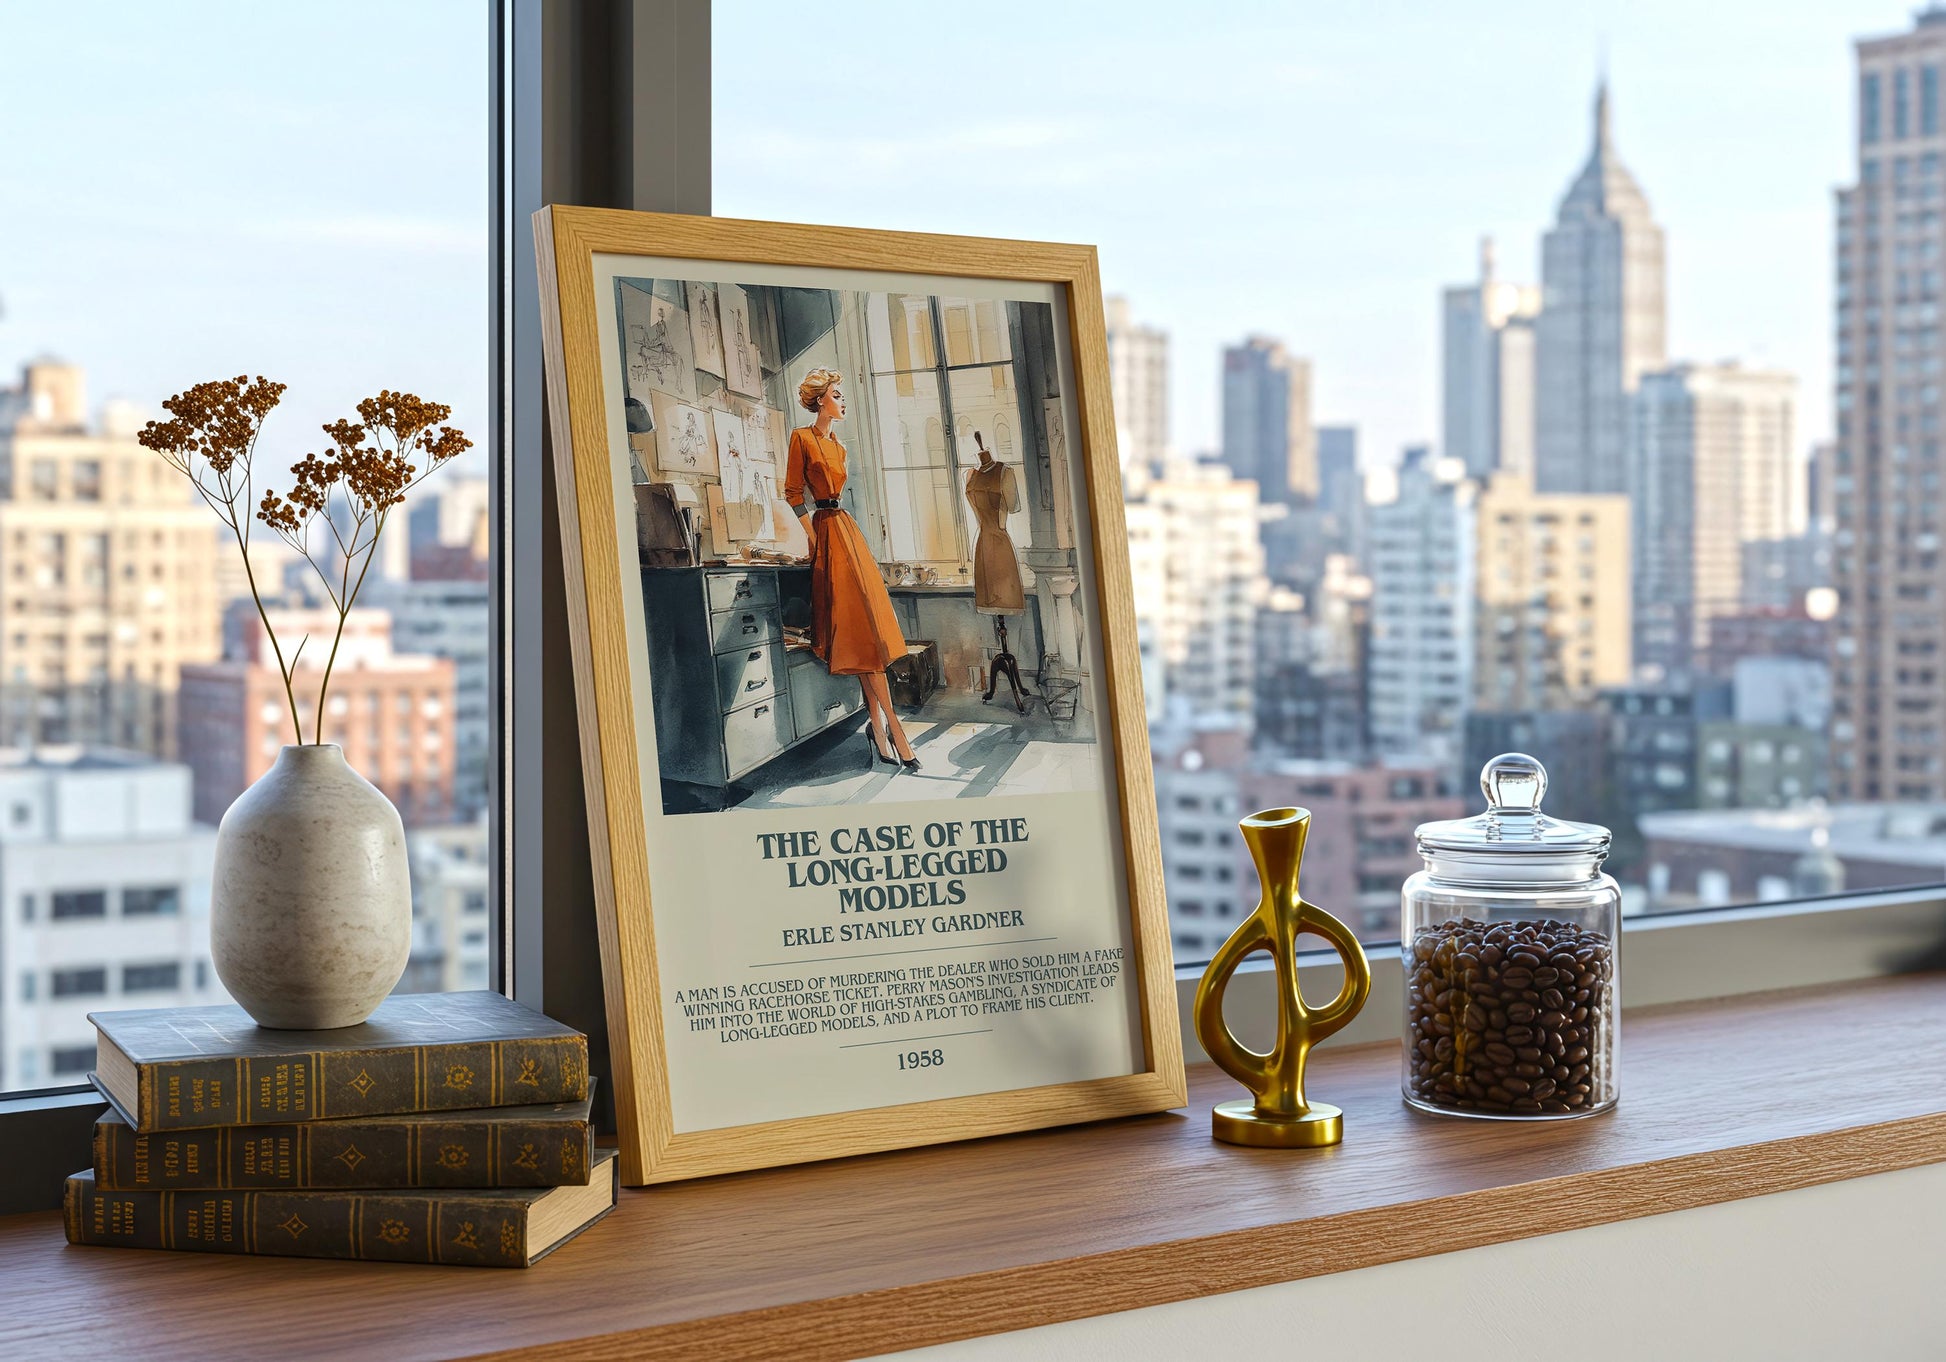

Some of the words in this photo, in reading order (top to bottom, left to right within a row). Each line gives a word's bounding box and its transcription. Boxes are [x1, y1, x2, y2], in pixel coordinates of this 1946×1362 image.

[756, 830, 821, 860] THE
[830, 825, 915, 855] CASE
[923, 821, 964, 848] OF
[970, 817, 1029, 845] THE
[786, 848, 1007, 888] LONG-LEGGED
[838, 879, 966, 914] MODELS
[782, 926, 835, 947] ERLE
[840, 918, 926, 942] STANLEY
[932, 910, 1025, 933] GARDNER
[675, 991, 685, 1003] A
[688, 987, 719, 1002] MAN
[723, 985, 736, 999] IS
[740, 979, 804, 997] ACCUSED
[808, 977, 826, 990] OF
[830, 969, 906, 988] MURDERING
[909, 966, 935, 980] THE
[938, 961, 986, 977] DEALER
[989, 958, 1019, 972] WHO
[1022, 955, 1055, 969] SOLD
[1058, 952, 1080, 965] HIM
[1083, 951, 1092, 963] A
[1095, 948, 1125, 962] FAKE
[683, 999, 745, 1017] WINNING
[748, 991, 831, 1011] RACEHORSE
[832, 985, 883, 1002] TICKET.
[886, 981, 926, 996] PERRY
[929, 975, 984, 992] MASON'S
[987, 965, 1079, 986] INVESTIGATION
[1082, 962, 1120, 976] LEADS
[690, 1017, 716, 1031] HIM
[720, 1013, 753, 1028] INTO
[756, 1010, 784, 1024] THE
[787, 1005, 836, 1021] WORLD
[840, 1002, 858, 1016] OF
[861, 993, 945, 1013] HIGH-STAKES
[948, 986, 1017, 1004] GAMBLING,
[1020, 985, 1029, 997] A
[1031, 977, 1098, 995] SYNDICATE
[1100, 975, 1117, 988] OF
[721, 1021, 817, 1043] LONG-LEGGED
[821, 1015, 879, 1032] MODELS,
[883, 1011, 910, 1025] AND
[914, 1010, 923, 1022] A
[926, 1006, 958, 1020] PLOT
[960, 1003, 979, 1016] TO
[982, 999, 1023, 1014] FRAME
[1025, 996, 1046, 1009] HIS
[1049, 991, 1094, 1007] CLIENT.
[898, 1049, 944, 1070] 1958
